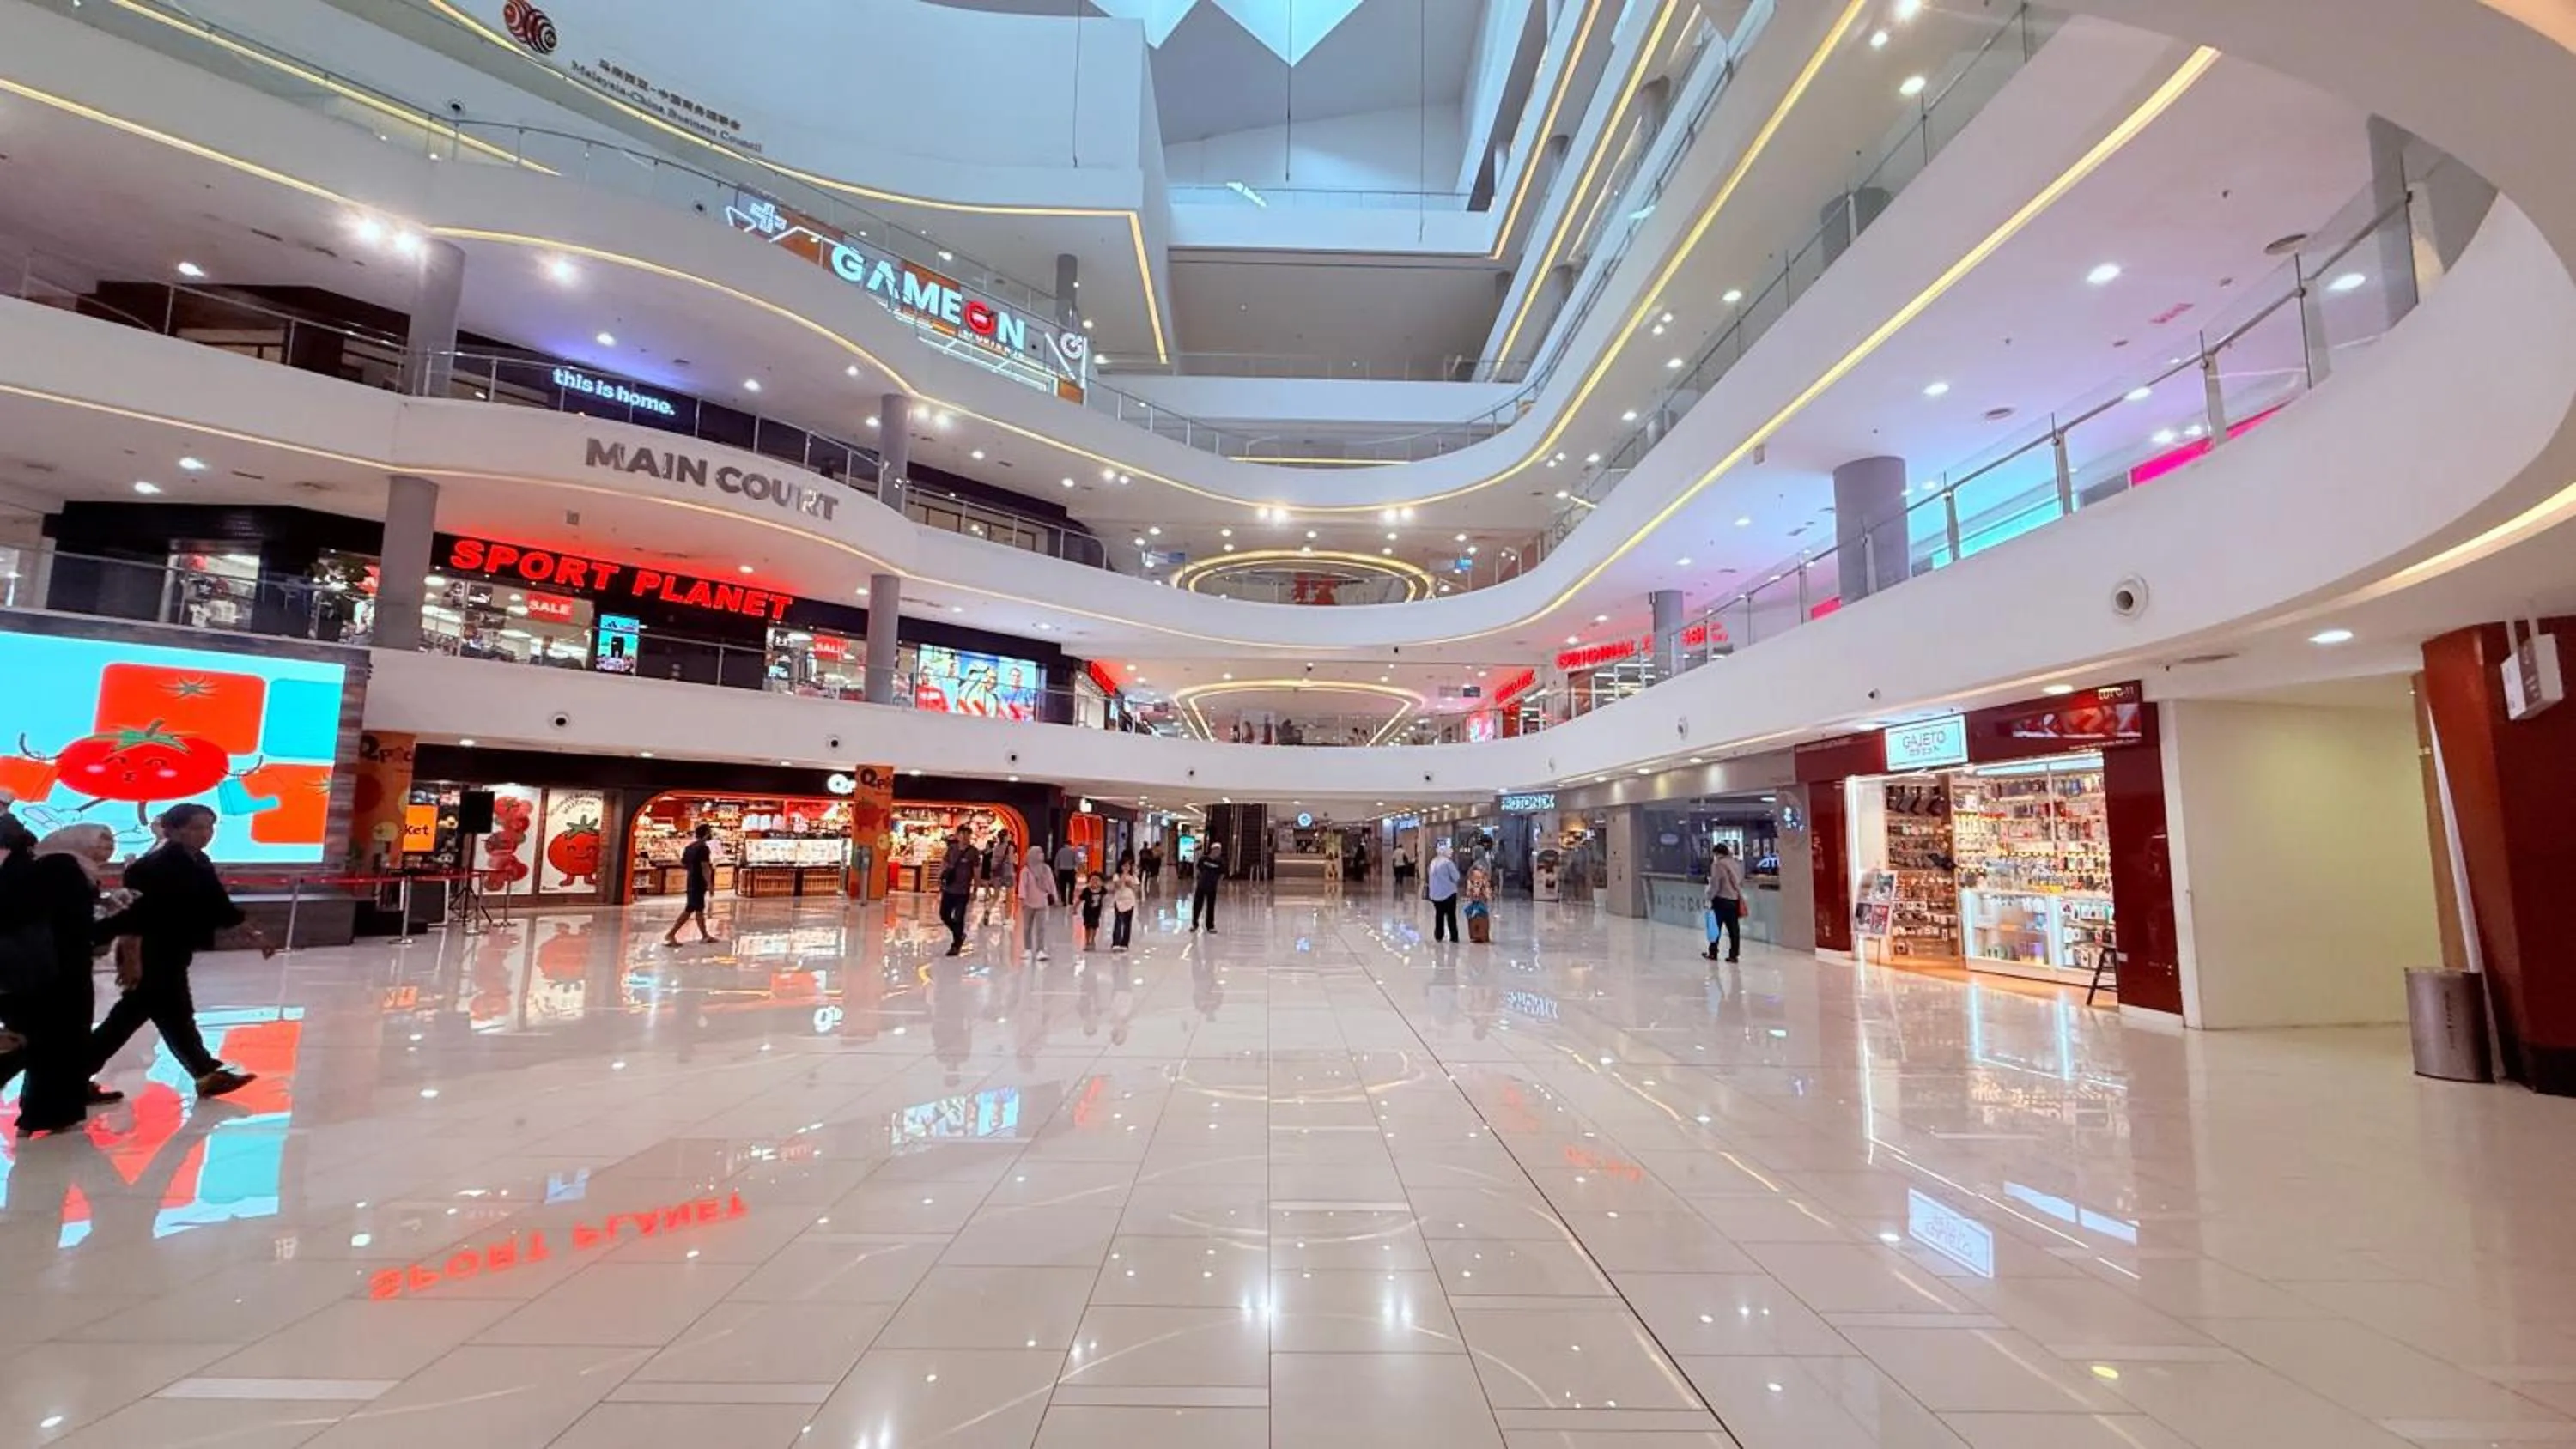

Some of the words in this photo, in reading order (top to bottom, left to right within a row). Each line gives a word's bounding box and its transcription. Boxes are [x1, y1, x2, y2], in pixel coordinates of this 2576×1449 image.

[571, 59, 665, 113] Malaysia-China
[667, 108, 717, 137] Business
[720, 130, 762, 153] Council
[552, 368, 594, 394] this
[595, 380, 615, 399] is
[616, 385, 676, 416] home.
[586, 437, 708, 487] MAIN
[715, 466, 839, 521] COURT
[450, 539, 621, 591] SPORT
[631, 569, 793, 620] PLANET
[528, 599, 573, 615] SALE
